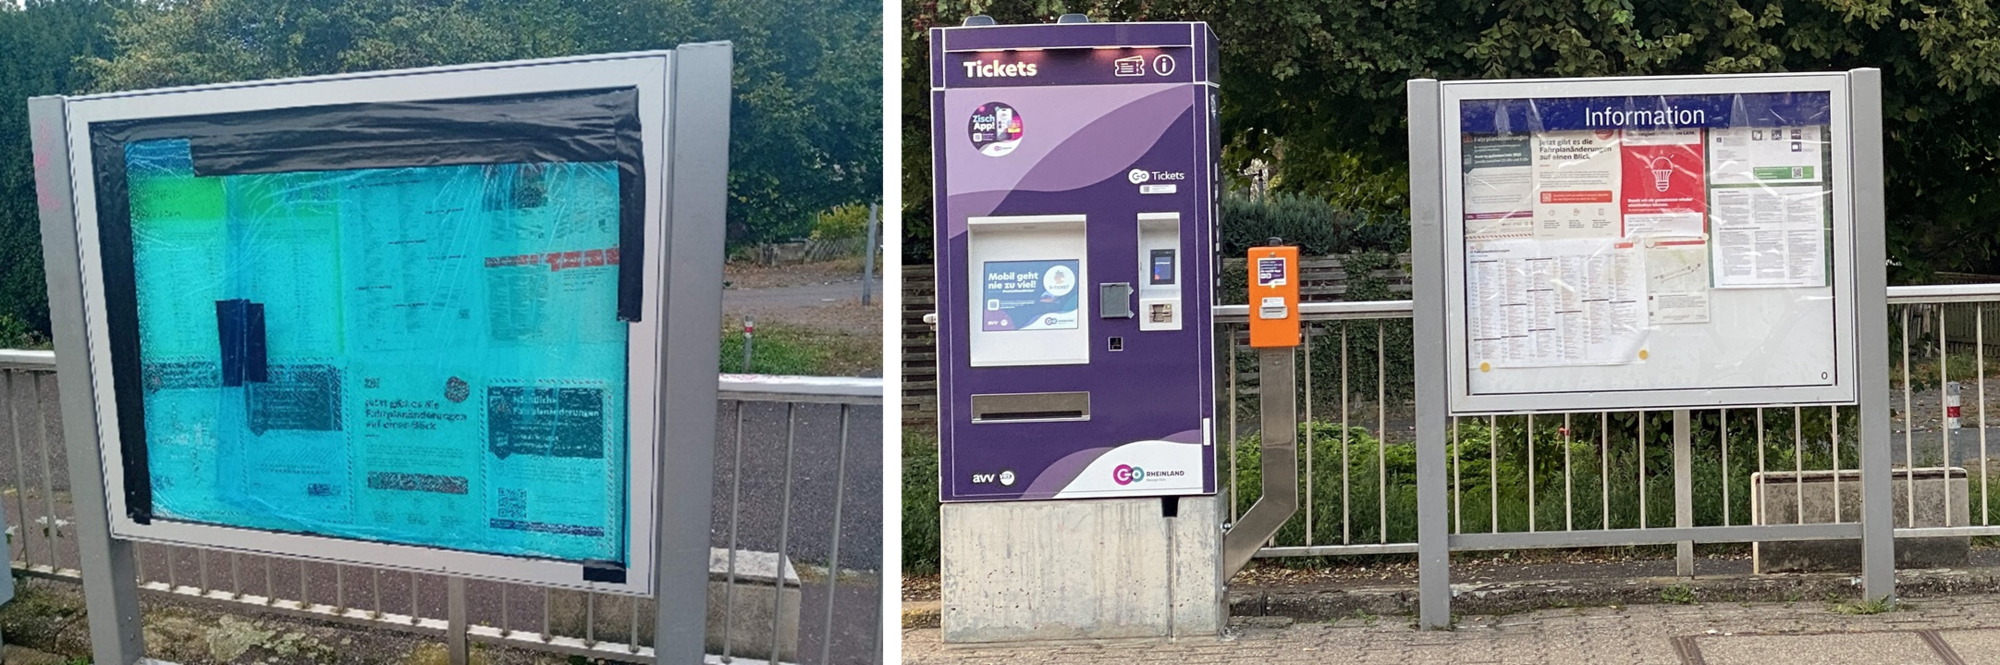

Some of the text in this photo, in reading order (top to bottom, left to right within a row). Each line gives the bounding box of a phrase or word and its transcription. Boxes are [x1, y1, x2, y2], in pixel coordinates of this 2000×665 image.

[963, 60, 1037, 77] Tickets
[972, 114, 996, 123] Zisch
[1586, 106, 1704, 126] Information
[973, 122, 995, 131] App!
[1151, 170, 1185, 180] Tickets
[988, 271, 1039, 282] Mobil geht
[988, 281, 1002, 289] nie
[1017, 280, 1036, 289] viel!
[972, 474, 995, 483] avv
